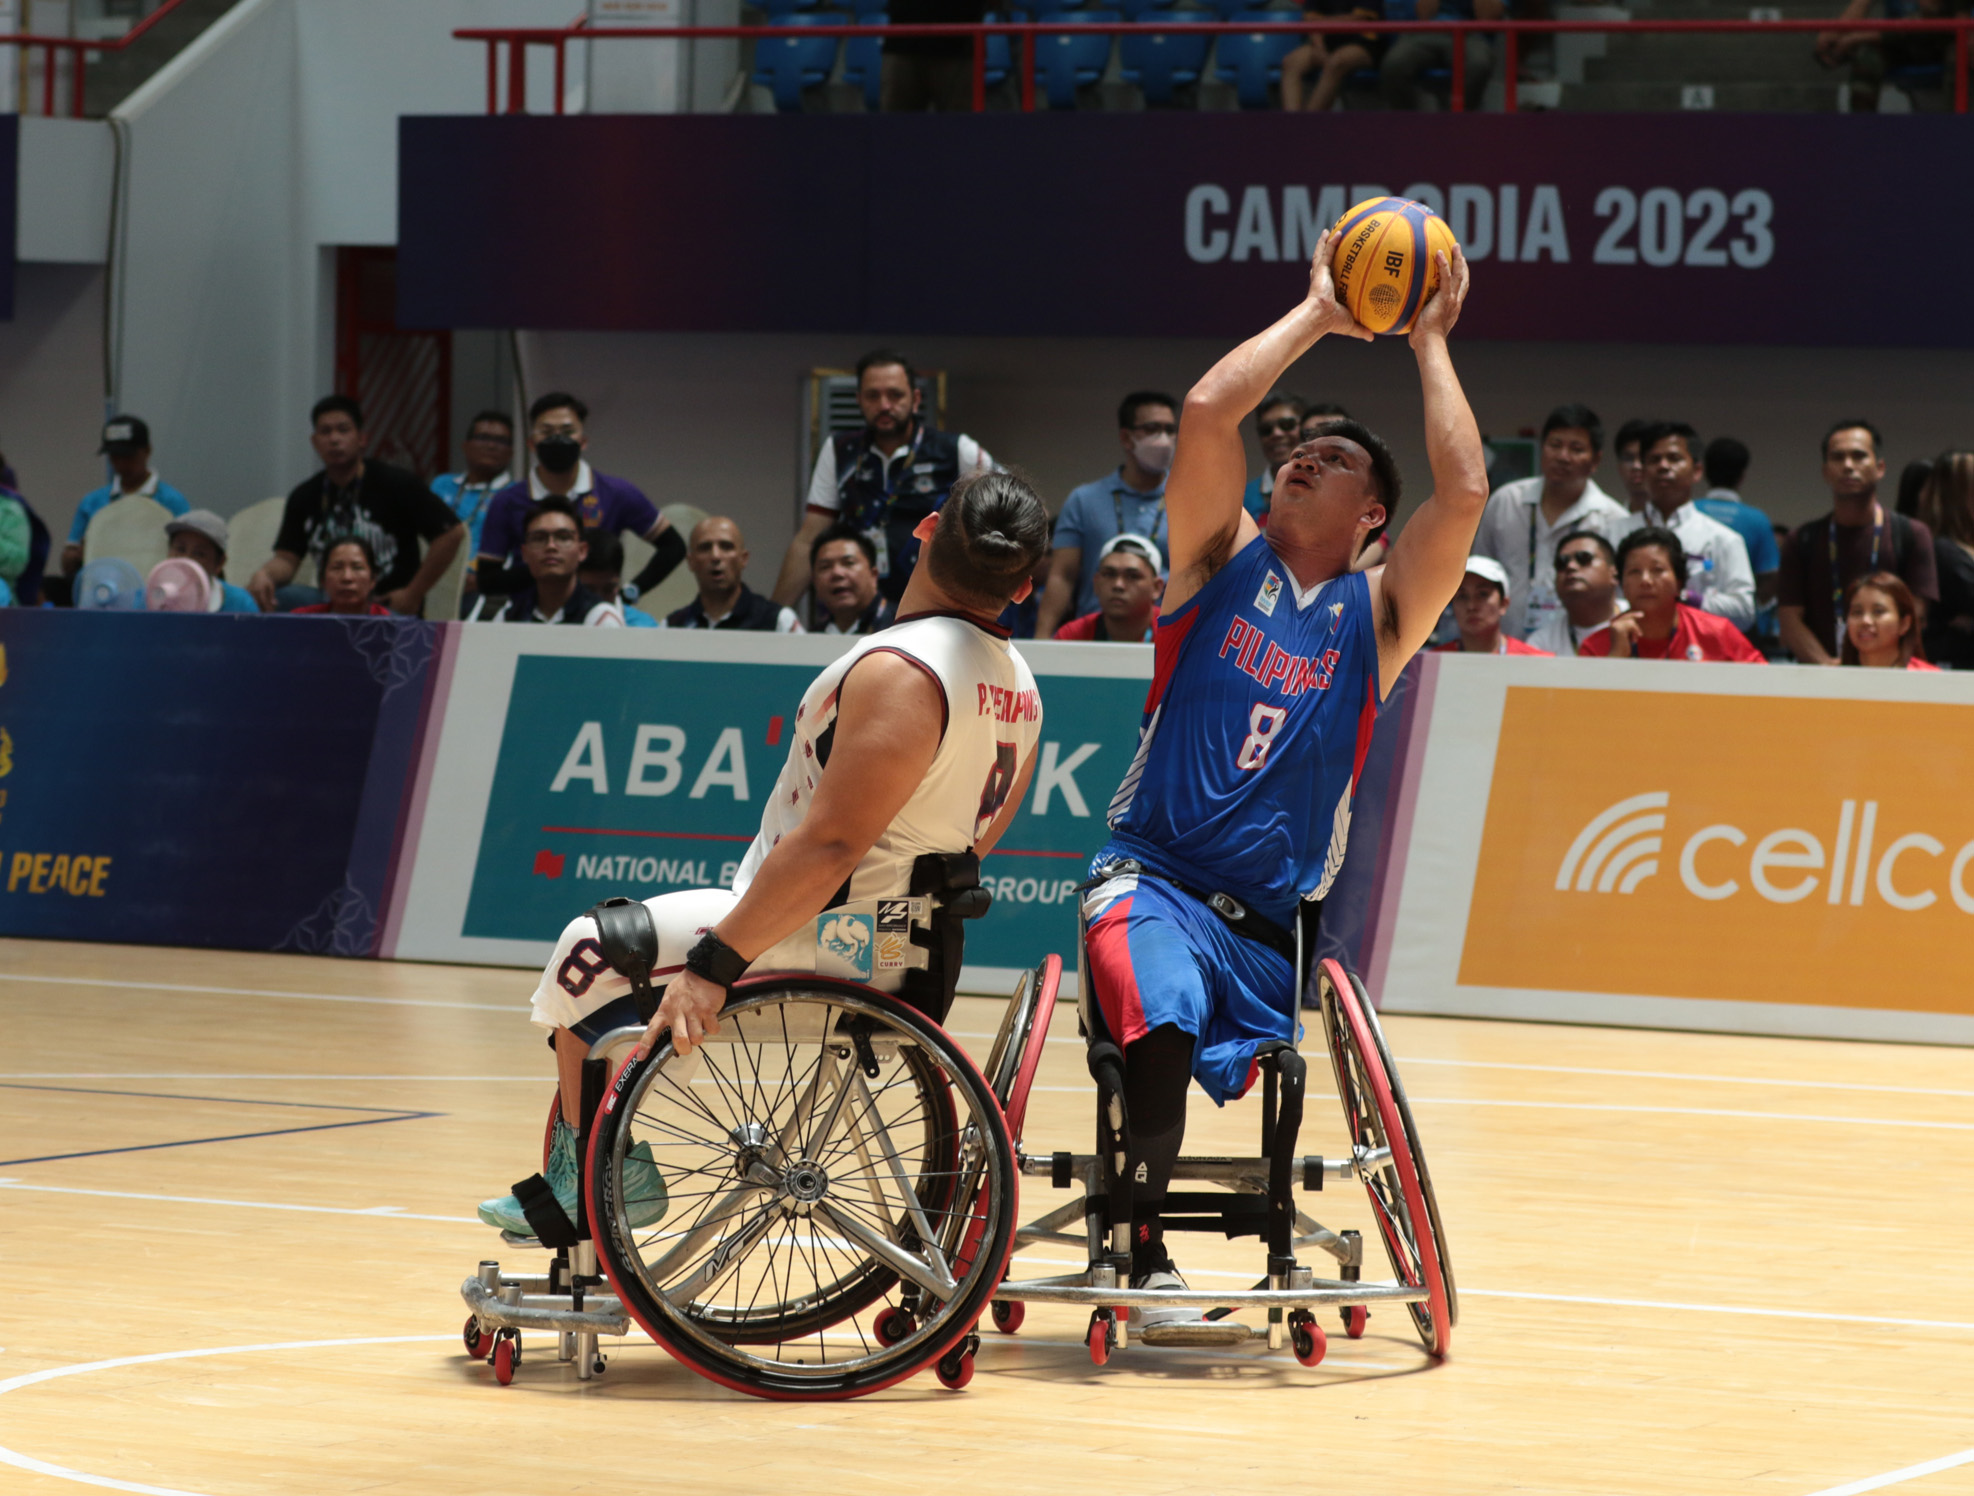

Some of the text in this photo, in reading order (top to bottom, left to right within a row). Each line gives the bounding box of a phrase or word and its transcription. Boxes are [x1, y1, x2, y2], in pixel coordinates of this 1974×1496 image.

[1340, 219, 1381, 280] BASKETBALL
[1593, 186, 1774, 269] 2023
[1384, 250, 1404, 278] IBF
[1236, 702, 1288, 769] 8
[7, 852, 112, 897] PEACE
[575, 855, 713, 885] NATIONAL
[979, 876, 1079, 904] GROUP
[556, 937, 612, 998] 8
